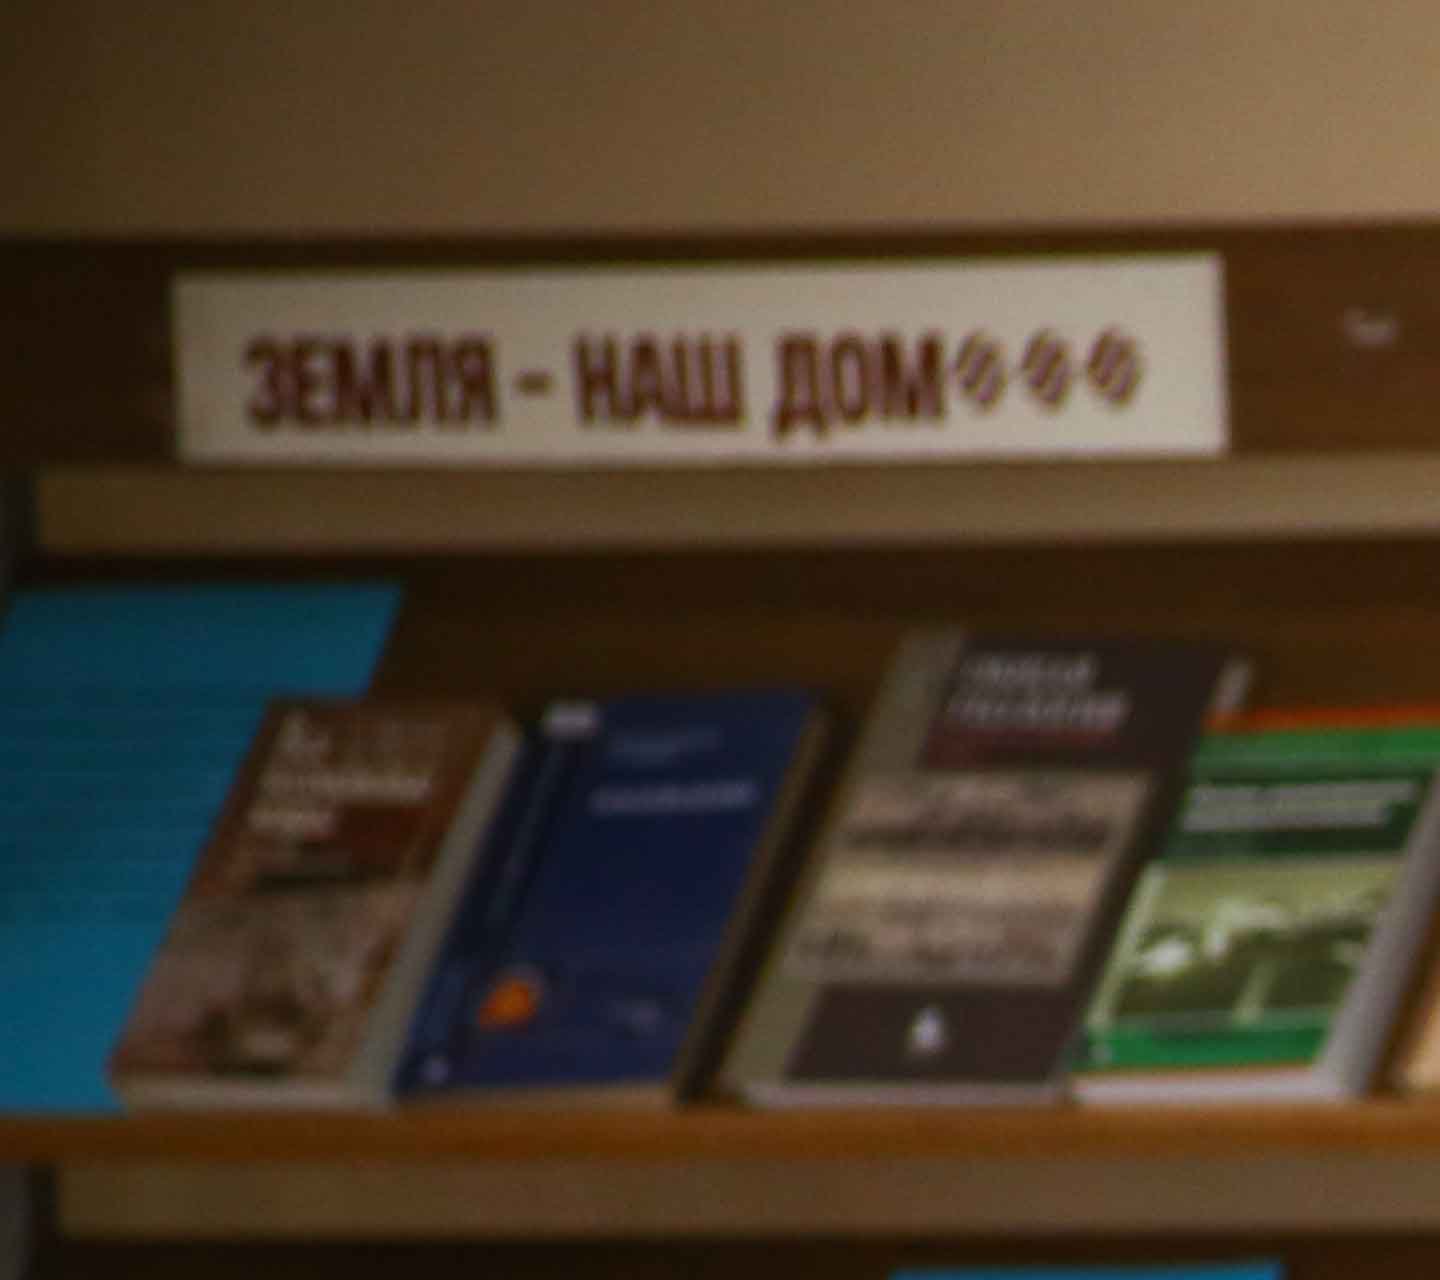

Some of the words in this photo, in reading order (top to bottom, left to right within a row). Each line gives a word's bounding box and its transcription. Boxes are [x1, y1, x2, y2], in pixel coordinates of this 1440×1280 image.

[243, 331, 498, 432] ЗЕМЛЯ
[571, 330, 745, 430] НАШ
[768, 330, 946, 444] ДОМ
